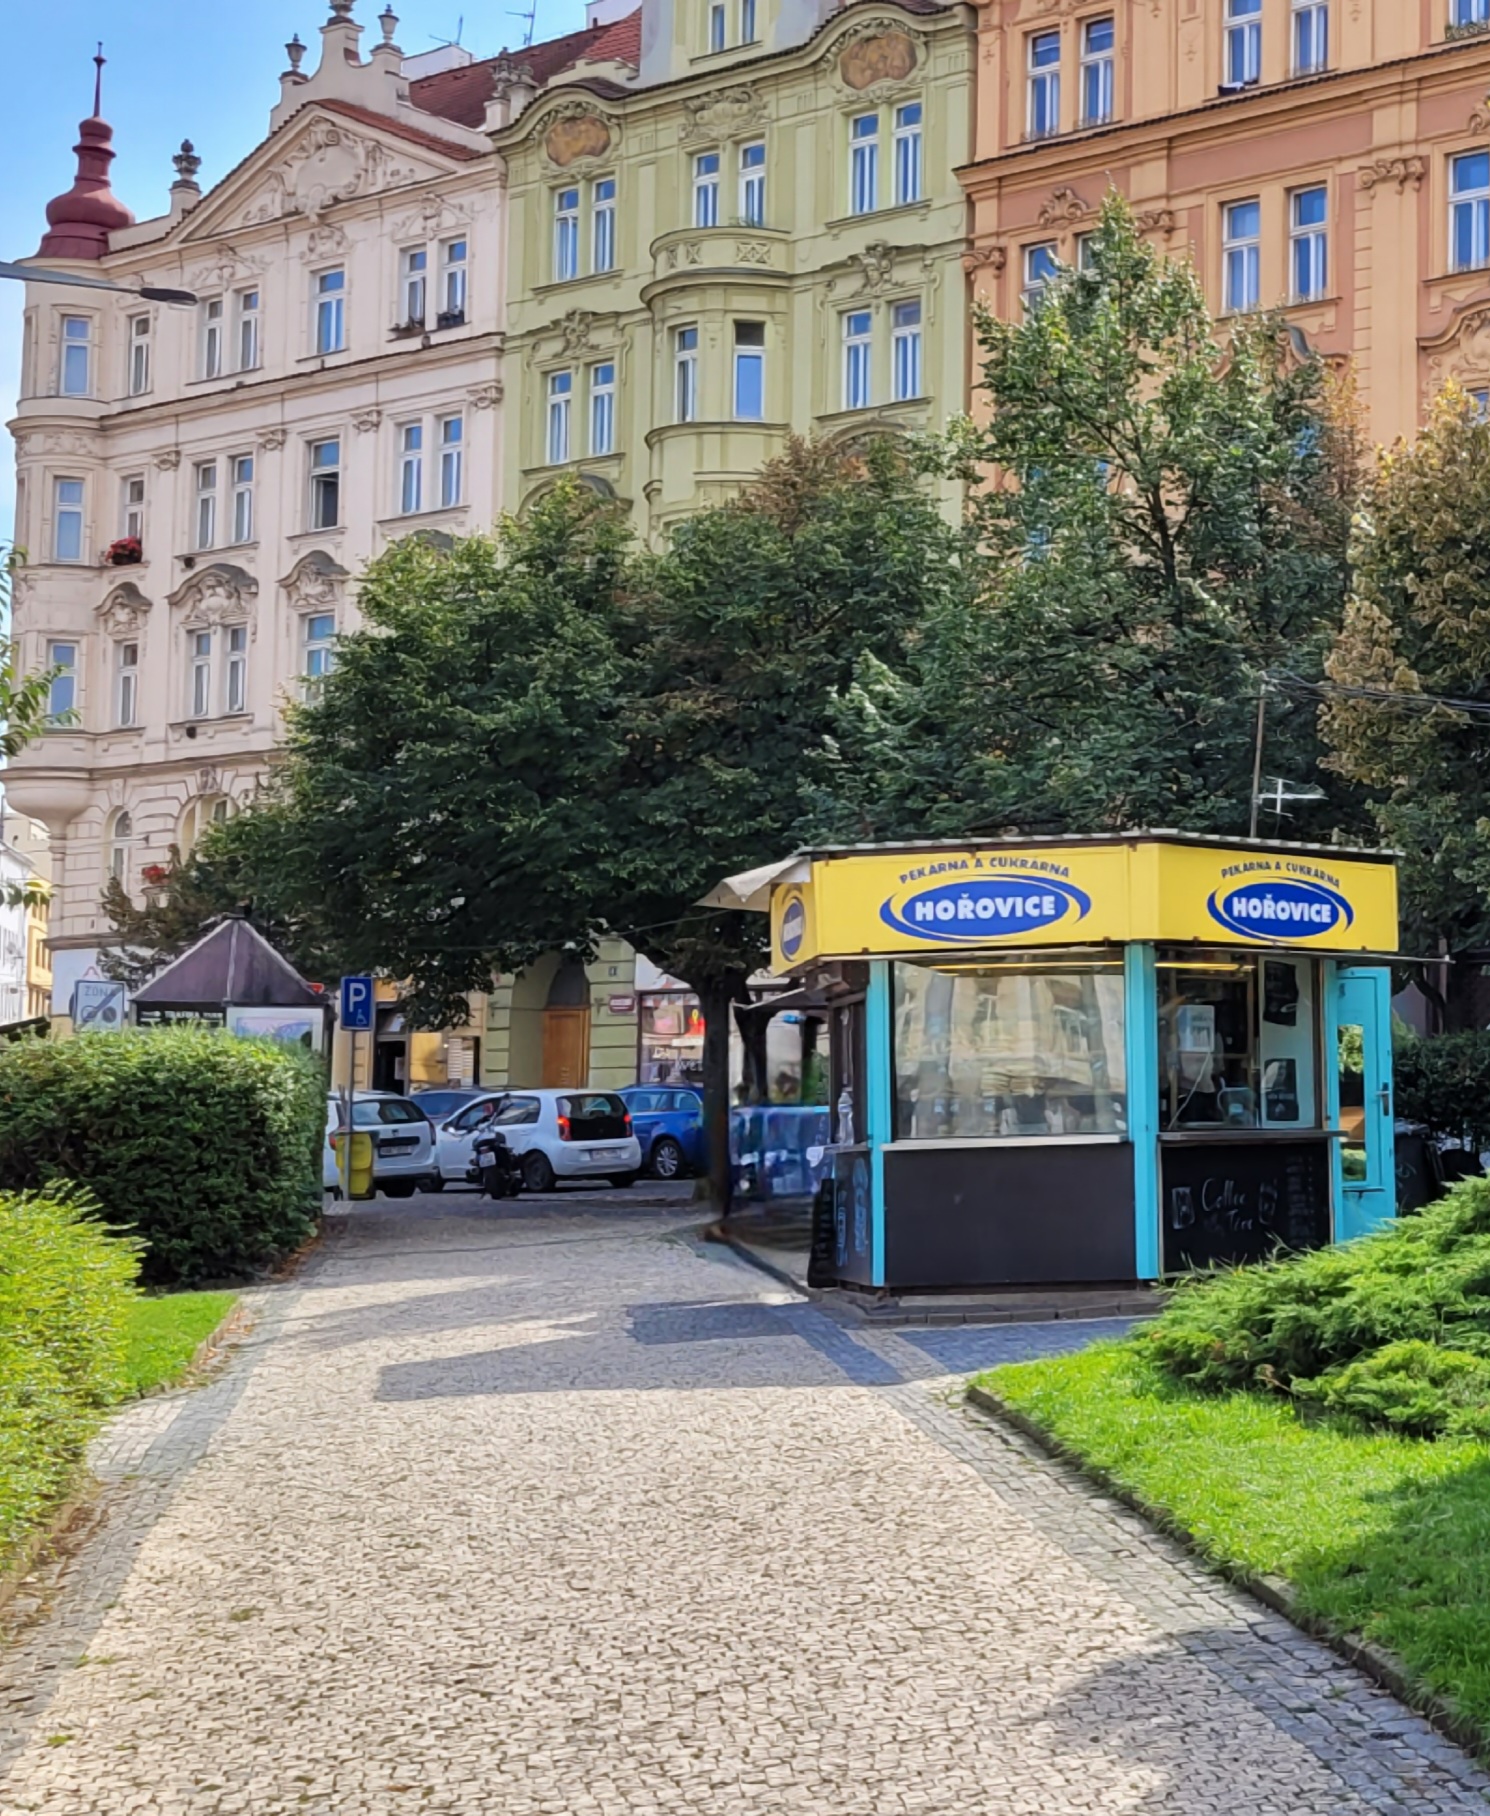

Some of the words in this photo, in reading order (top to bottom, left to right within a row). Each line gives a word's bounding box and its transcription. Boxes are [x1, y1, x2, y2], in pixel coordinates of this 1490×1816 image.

[974, 857, 984, 868] A
[915, 893, 1056, 921] HOŘOVICE
[1232, 893, 1332, 923] HOŘOVICE
[349, 983, 366, 1013] P
